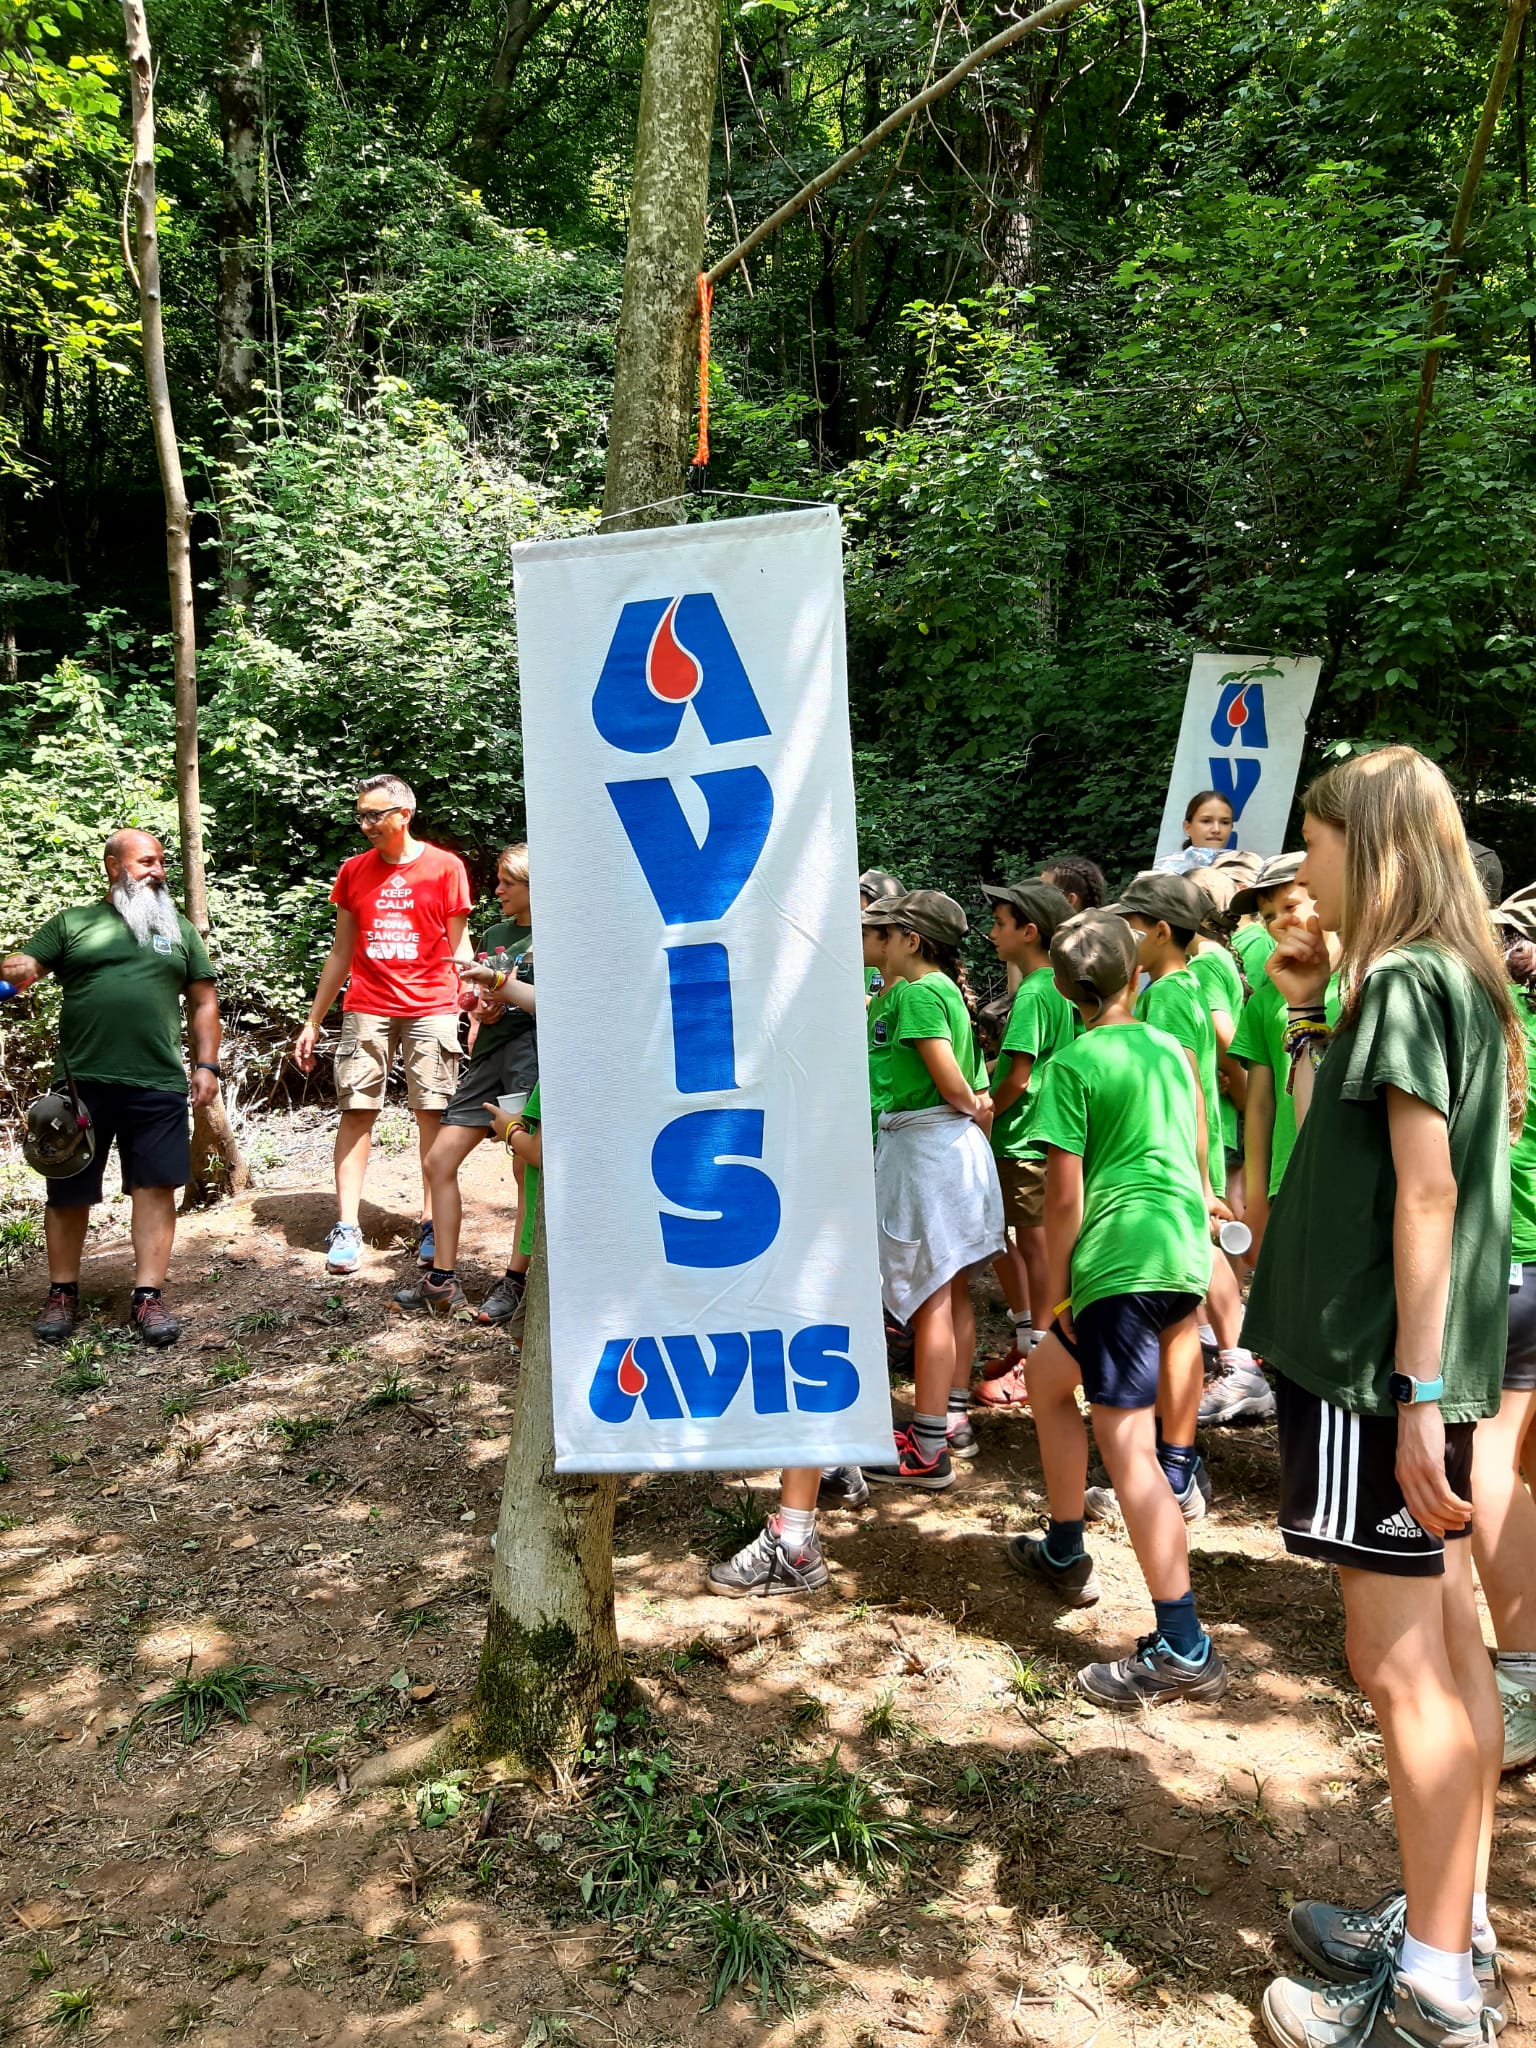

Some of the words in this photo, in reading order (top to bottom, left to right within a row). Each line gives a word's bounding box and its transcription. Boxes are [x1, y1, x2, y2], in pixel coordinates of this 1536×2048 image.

[381, 888, 413, 898] KEEP
[375, 899, 415, 909] CALM
[373, 918, 413, 930] DONA
[367, 930, 420, 942] SANGUE
[591, 592, 781, 1269] AVIS
[588, 1324, 860, 1424] AVIS
[1375, 1523, 1423, 1538] adidas
